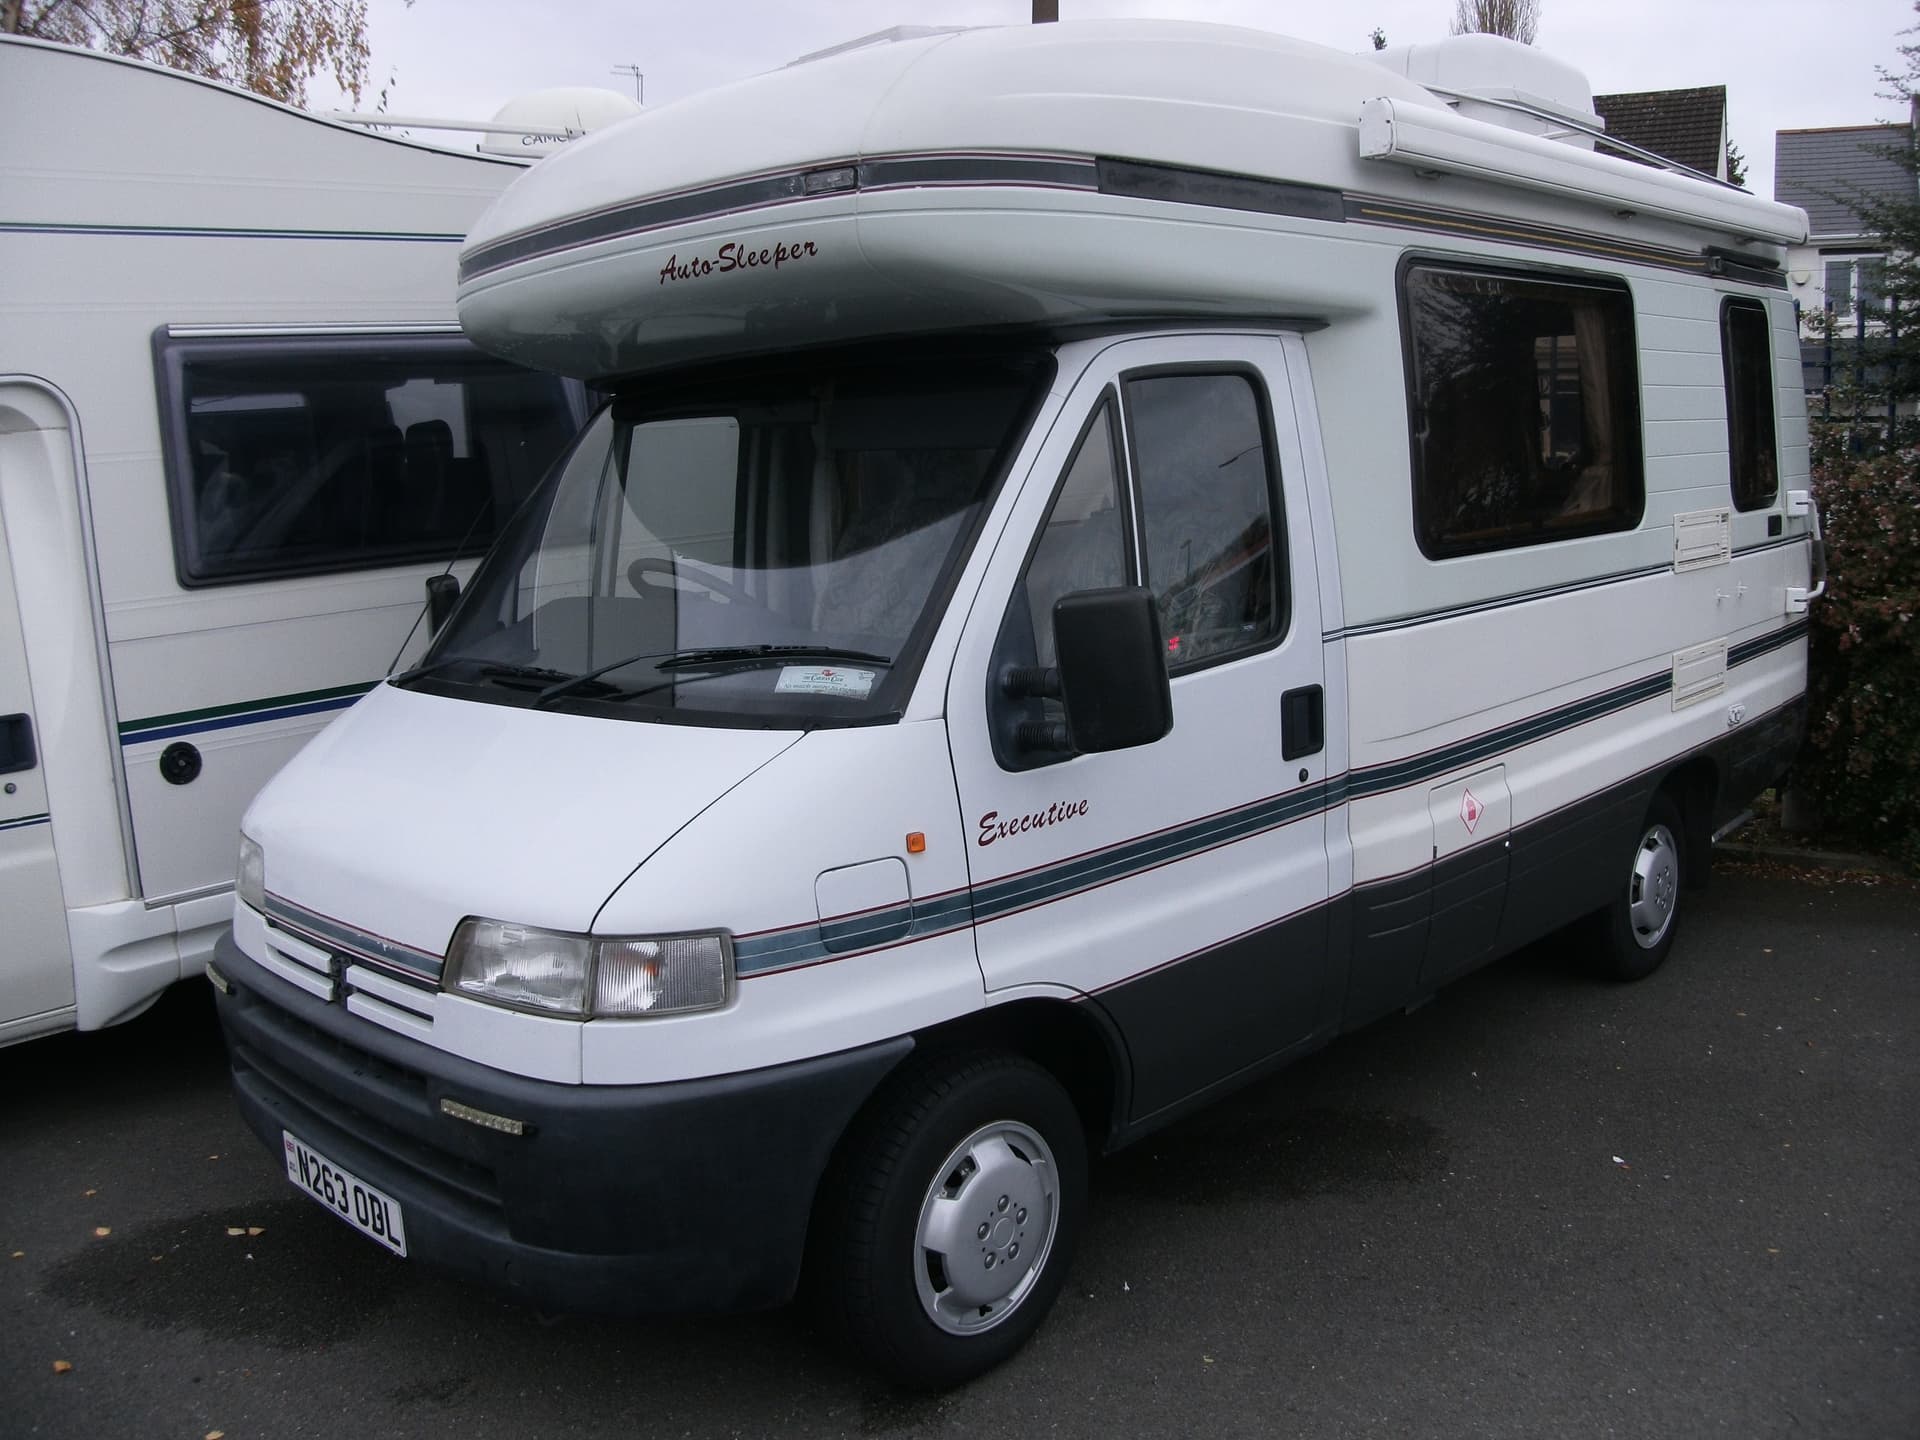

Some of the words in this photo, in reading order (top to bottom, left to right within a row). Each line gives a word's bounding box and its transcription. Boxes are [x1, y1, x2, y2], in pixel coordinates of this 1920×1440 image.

[660, 241, 818, 284] Auto-Sleeper
[978, 799, 1089, 847] Executive
[297, 1145, 349, 1214] N263
[354, 1184, 401, 1248] OBL
